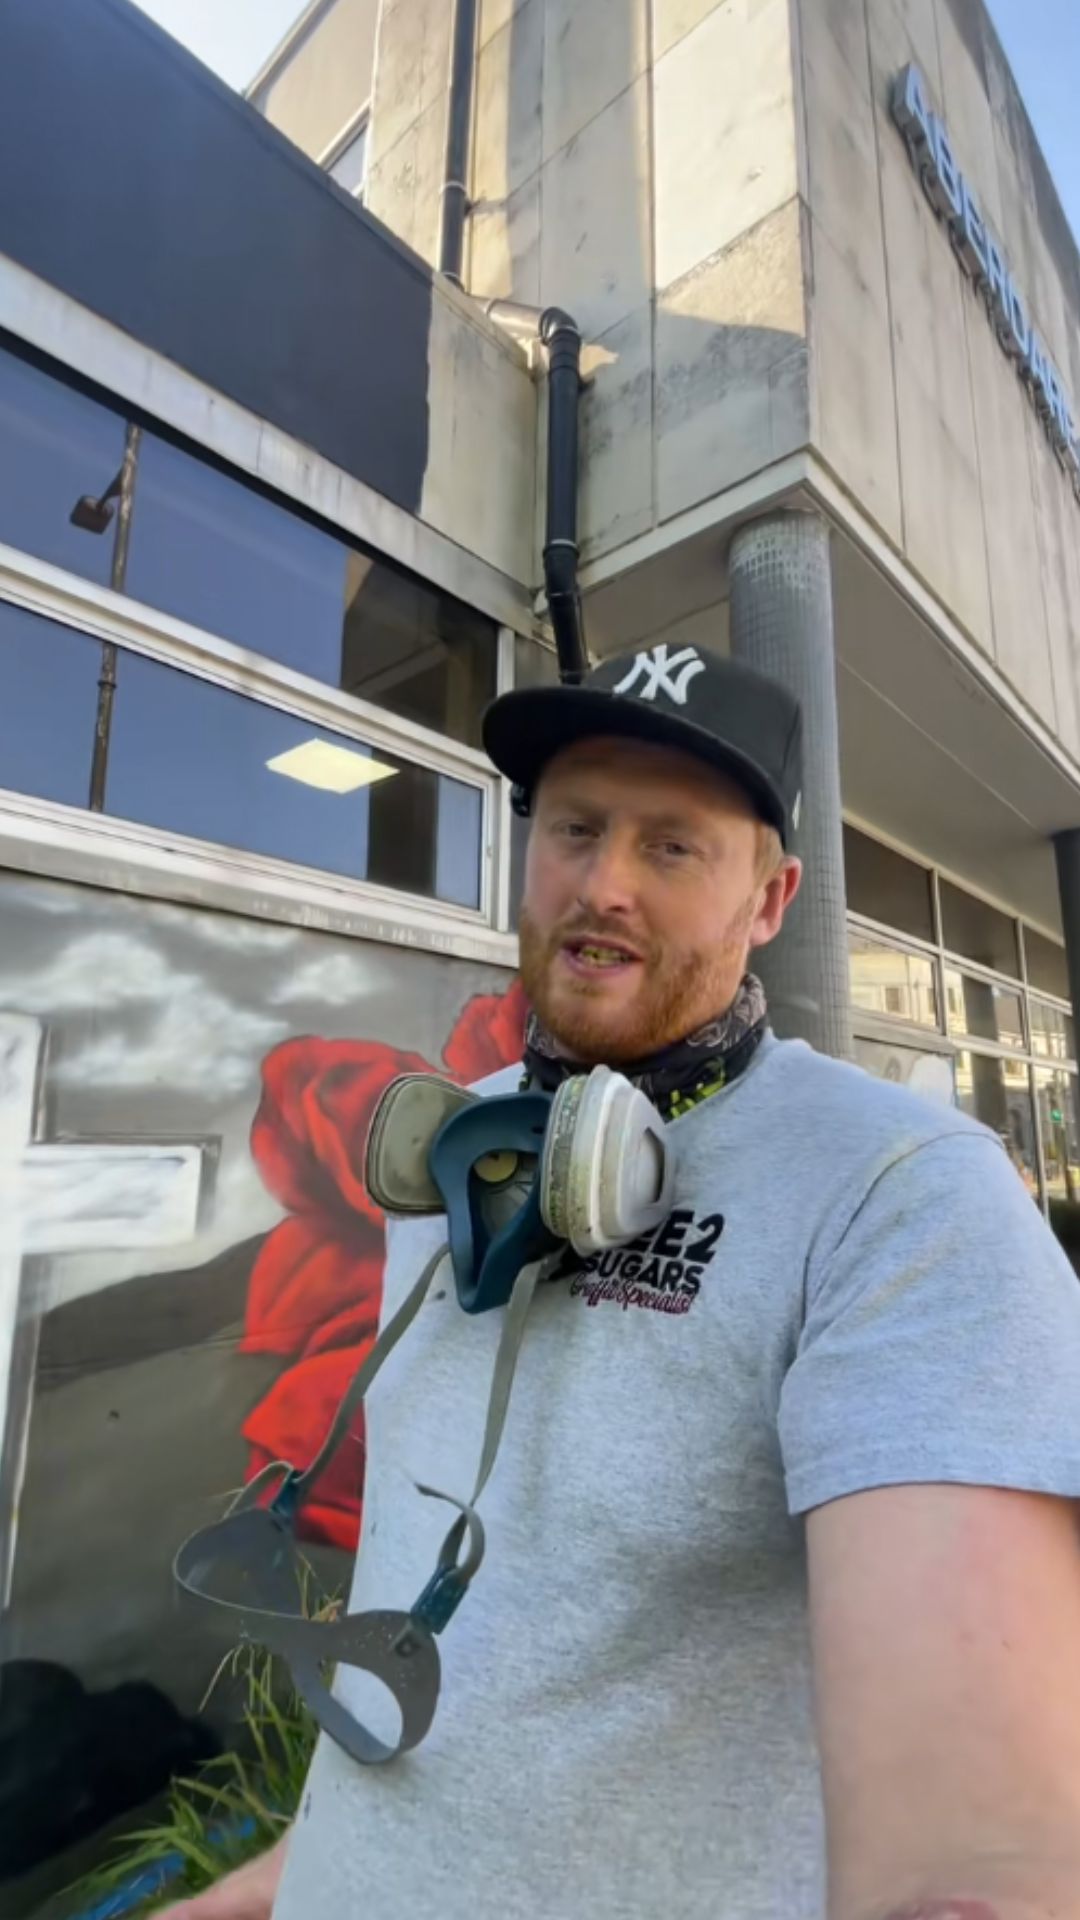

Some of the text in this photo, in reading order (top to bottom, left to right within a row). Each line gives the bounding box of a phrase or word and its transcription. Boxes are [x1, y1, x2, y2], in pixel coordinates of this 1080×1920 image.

[613, 643, 706, 705] NY
[616, 1209, 725, 1264] E2
[579, 1249, 704, 1295] SUGARS
